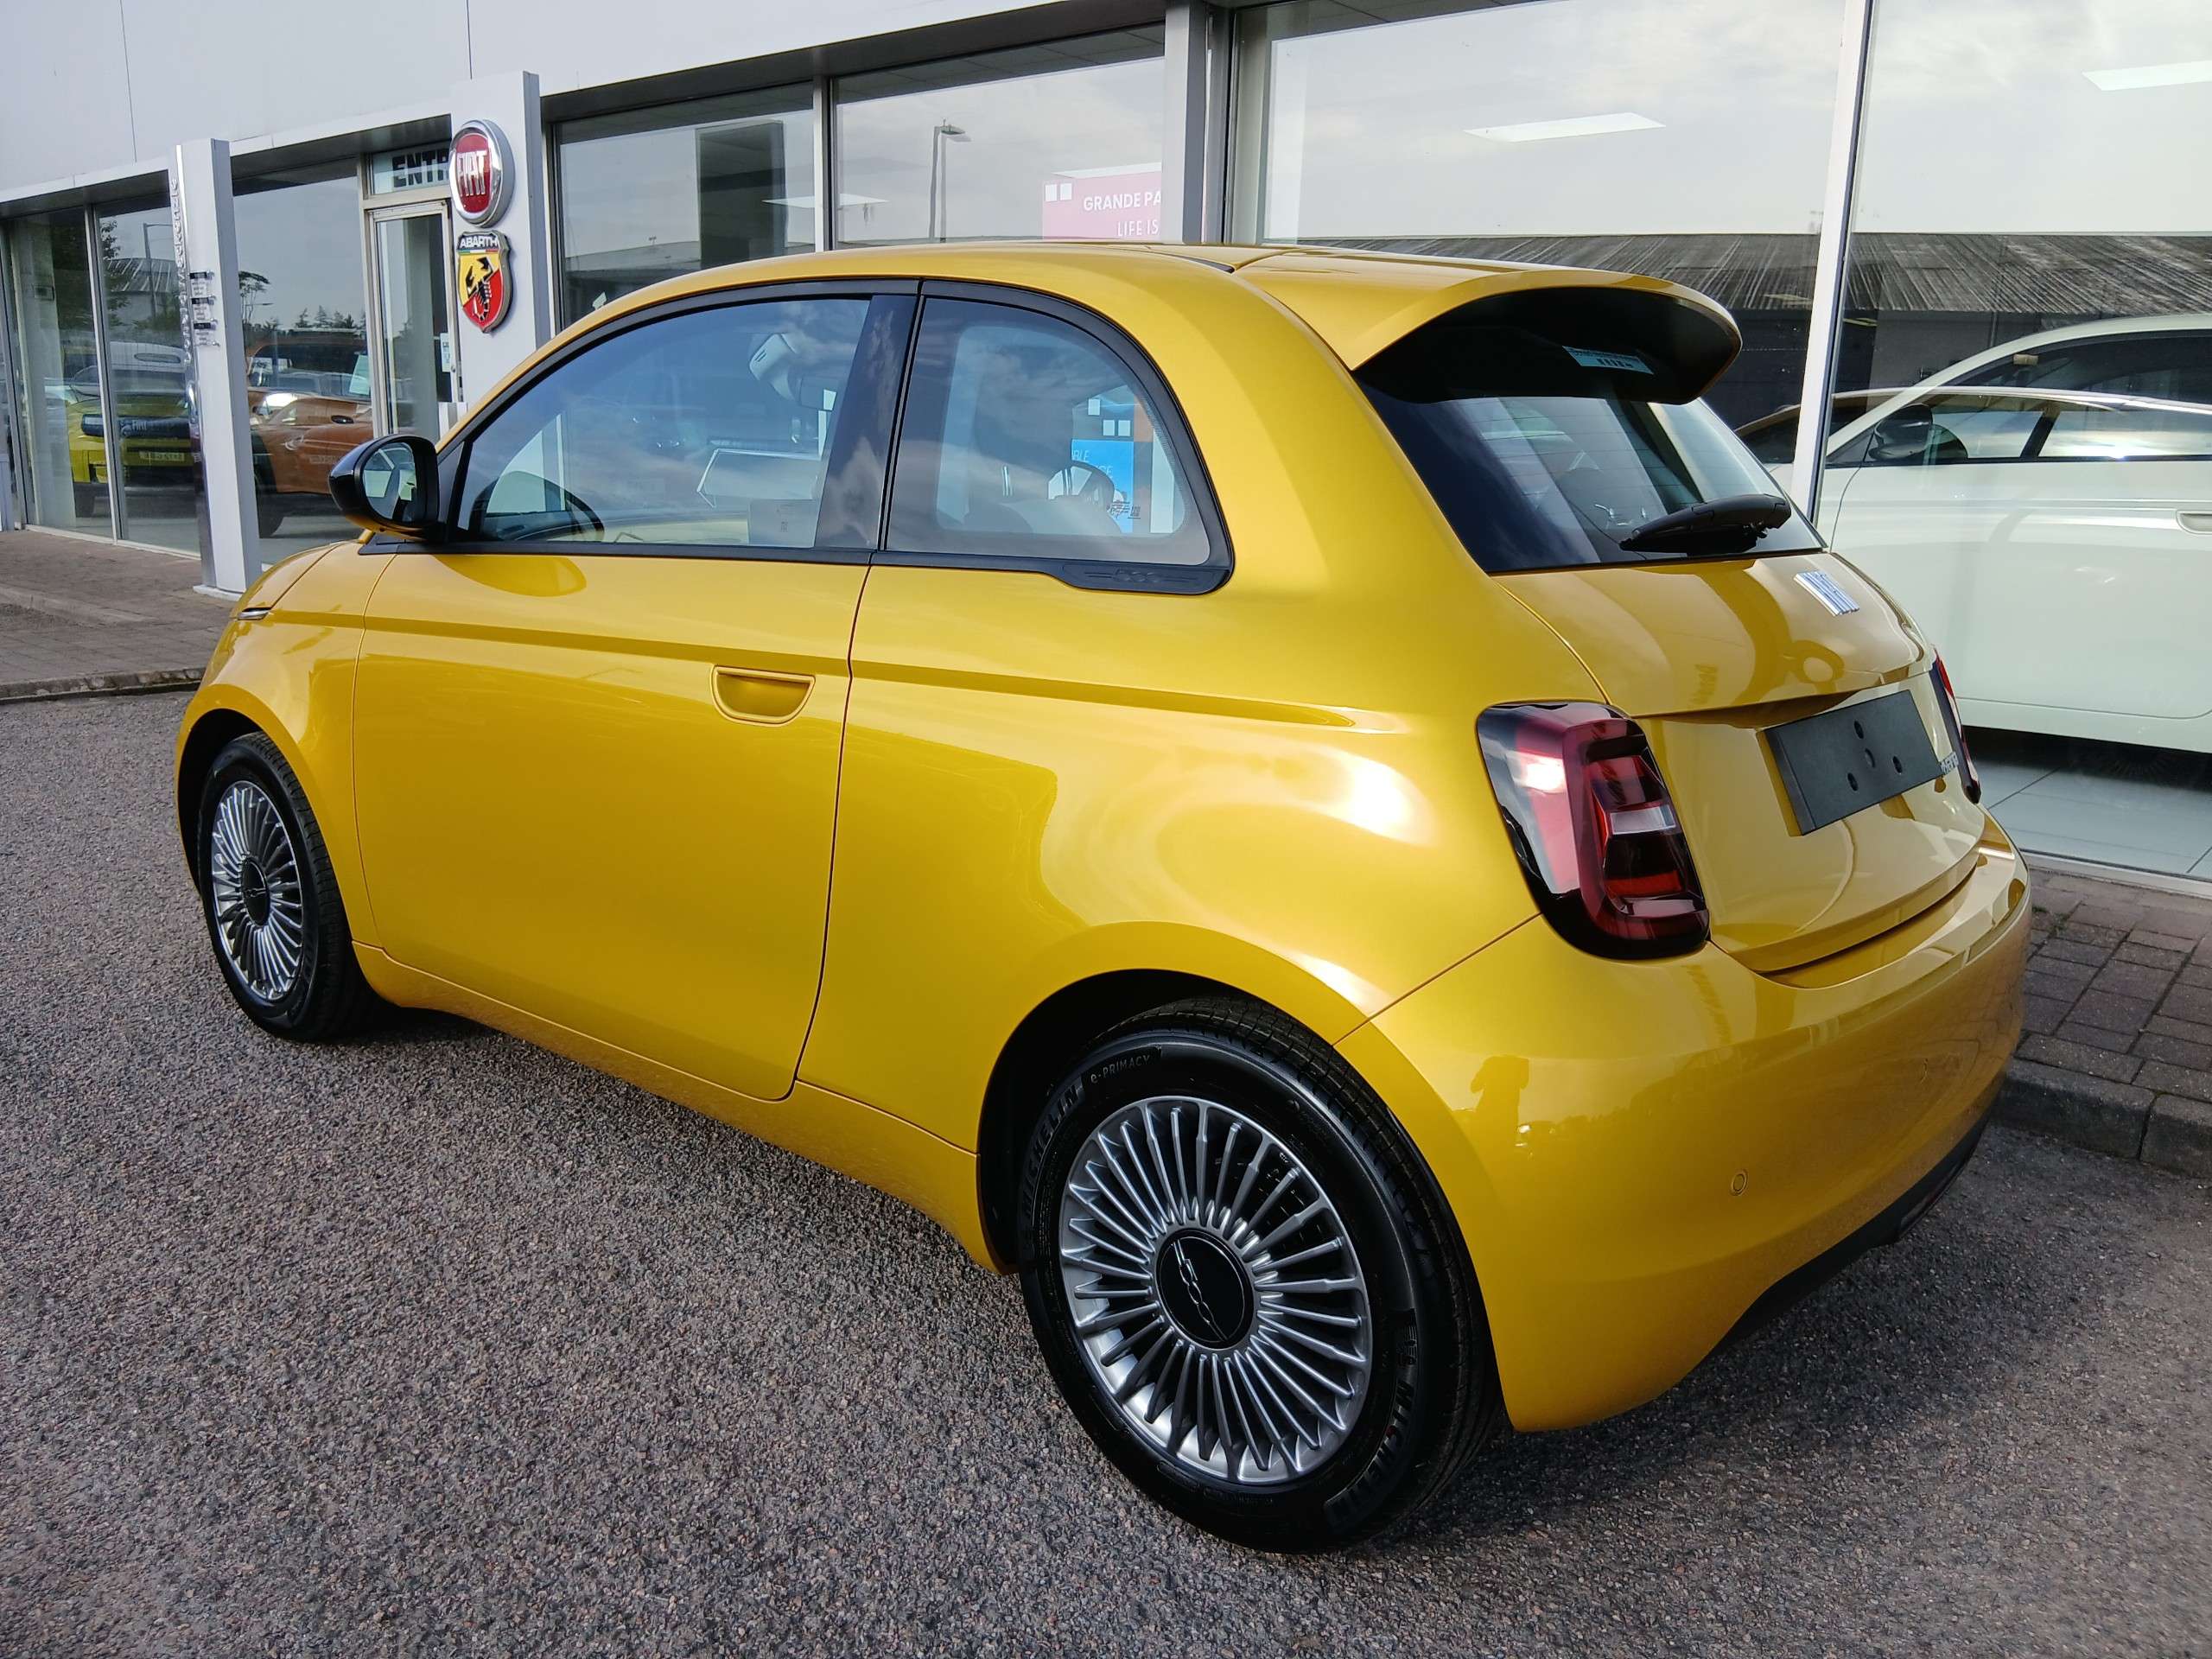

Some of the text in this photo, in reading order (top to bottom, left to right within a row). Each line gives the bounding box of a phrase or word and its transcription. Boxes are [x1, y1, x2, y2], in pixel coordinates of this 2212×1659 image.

[456, 150, 487, 197] FIAT
[1084, 192, 1141, 211] GRANDE
[1117, 219, 1159, 237] LIFE IS
[460, 236, 499, 248] ABARTH
[1021, 1054, 1151, 1219] MICHELIN e-PRIMACY
